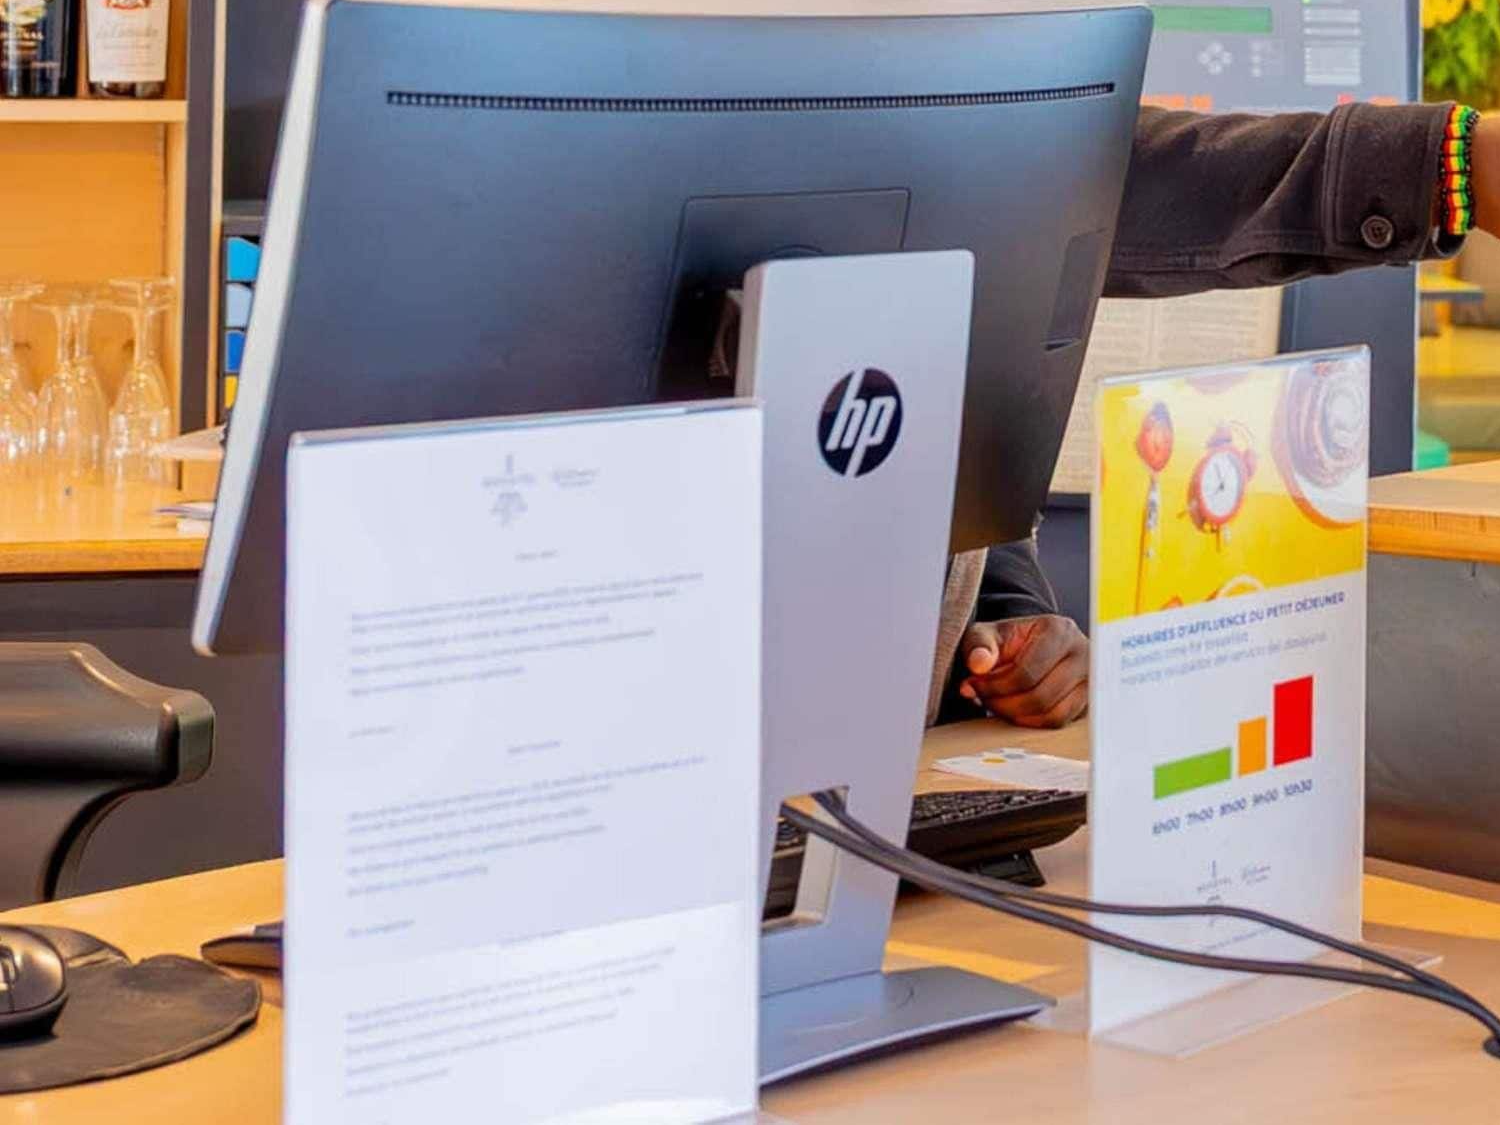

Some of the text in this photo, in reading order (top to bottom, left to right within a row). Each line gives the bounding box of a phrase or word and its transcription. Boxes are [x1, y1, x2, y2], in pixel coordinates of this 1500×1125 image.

[825, 368, 896, 476] hp
[1121, 627, 1175, 649] HORAIRES
[1250, 609, 1264, 622] DU
[1267, 603, 1293, 618] PETIT
[1152, 817, 1181, 835] 6h00
[1186, 806, 1214, 825] 7h00
